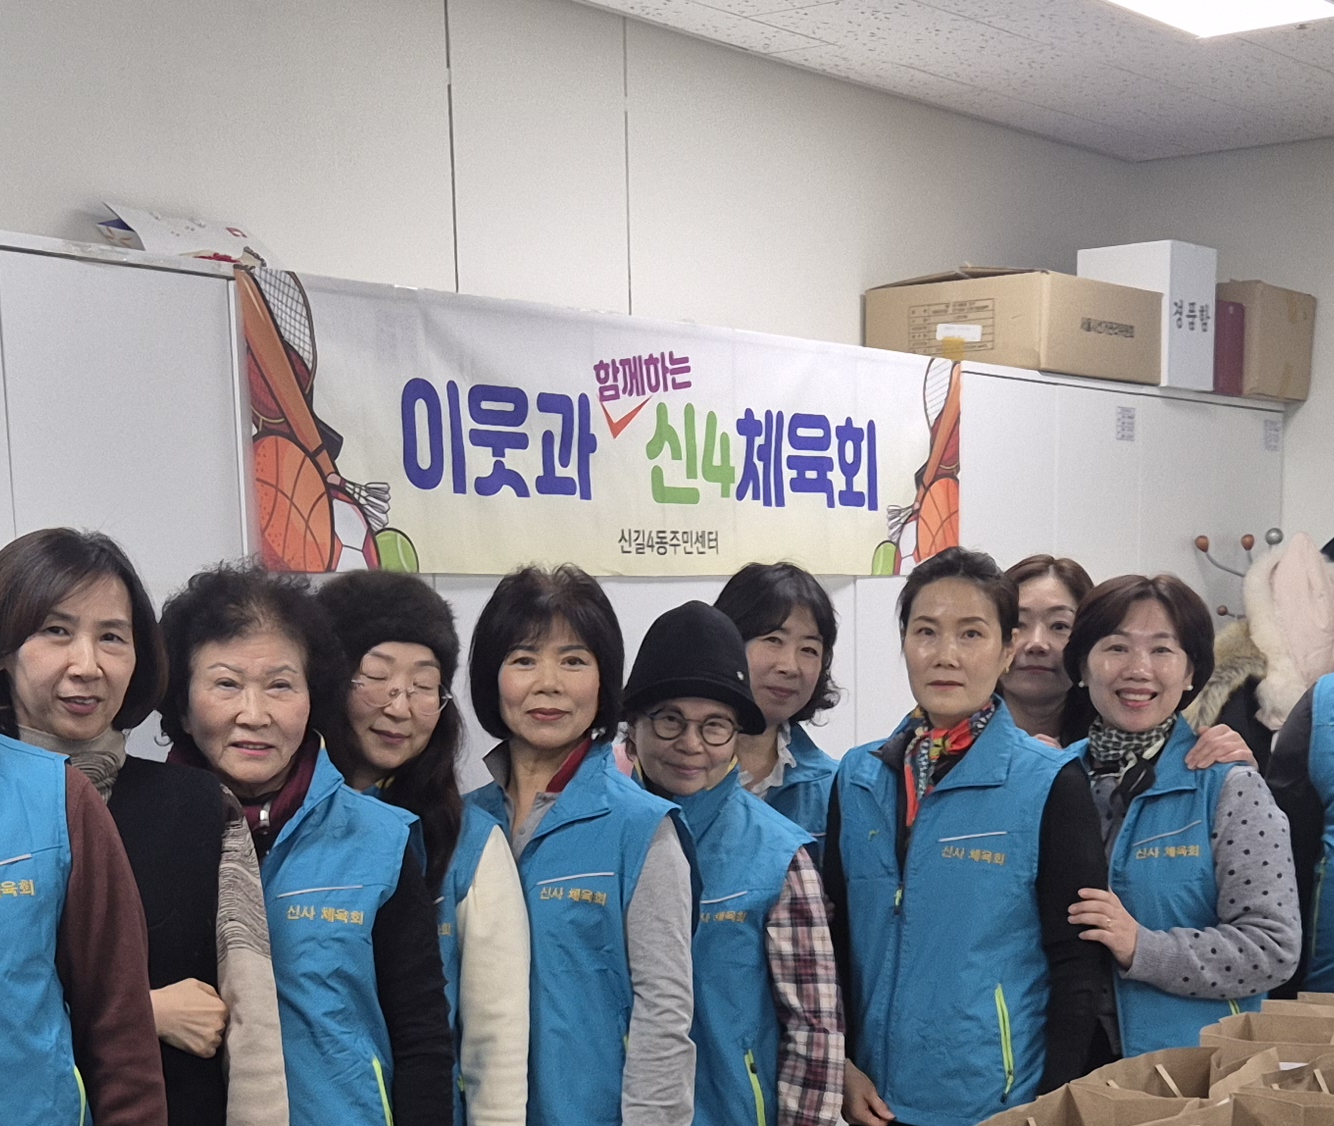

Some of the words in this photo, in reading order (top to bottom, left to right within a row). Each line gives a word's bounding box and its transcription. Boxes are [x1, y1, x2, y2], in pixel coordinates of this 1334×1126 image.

[594, 350, 693, 402] 함께하는
[400, 376, 598, 501] 이웃과
[644, 402, 880, 511] 신4체육회
[617, 527, 720, 556] 신길4동주민센터
[940, 846, 966, 860] 신사
[968, 847, 1006, 866] 체육회
[1135, 847, 1161, 861] 신사
[1163, 844, 1201, 859] 체육회
[539, 886, 565, 901] 신사
[566, 887, 608, 907] 체육회
[286, 904, 317, 921] 신사
[320, 906, 365, 926] 체육회
